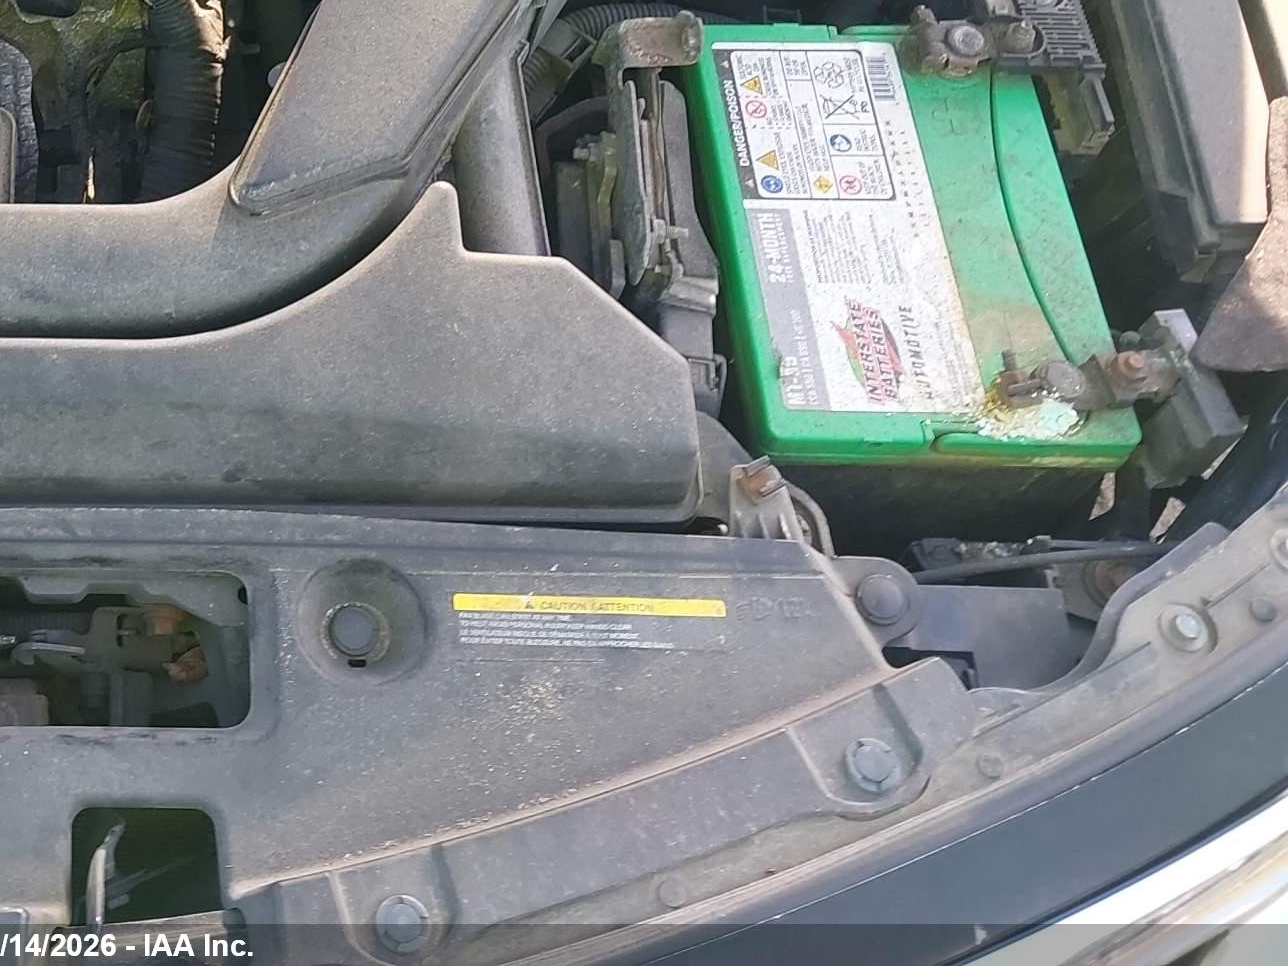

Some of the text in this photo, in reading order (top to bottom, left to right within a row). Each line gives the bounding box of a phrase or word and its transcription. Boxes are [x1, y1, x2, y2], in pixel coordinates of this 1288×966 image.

[724, 79, 750, 166] DANGER/POISON
[756, 212, 786, 282] 24-MONTH
[773, 213, 791, 262] REPLACEMENT
[846, 302, 882, 403] INTERSTATE
[864, 309, 898, 399] BATTERIES
[897, 305, 934, 399] AUTOMOTIVE
[540, 600, 586, 611] CAUTION
